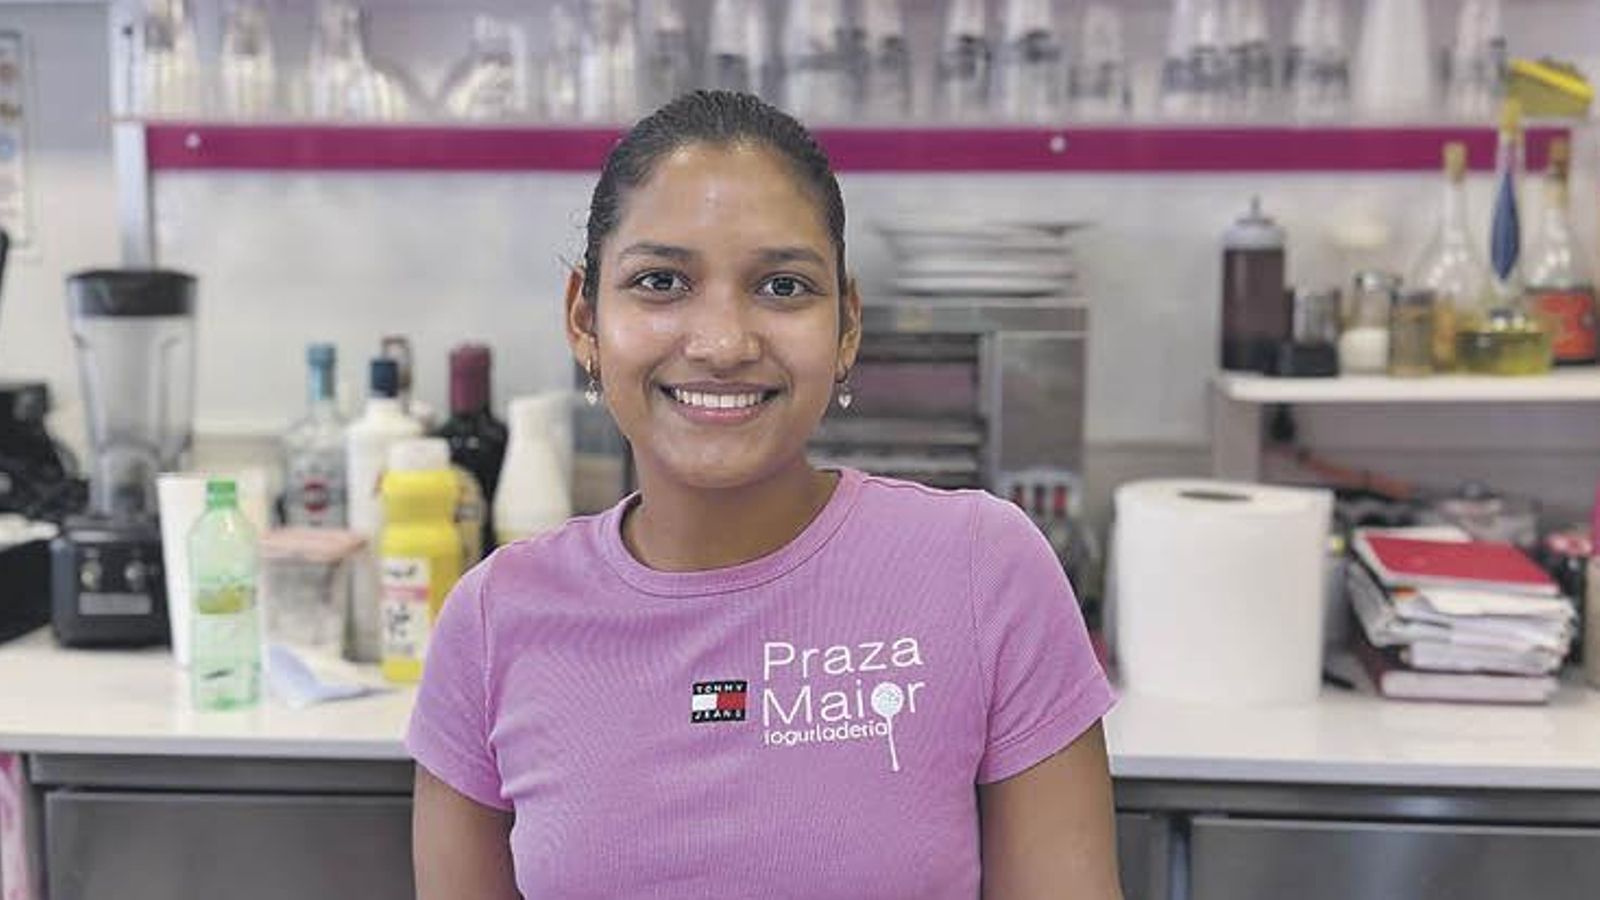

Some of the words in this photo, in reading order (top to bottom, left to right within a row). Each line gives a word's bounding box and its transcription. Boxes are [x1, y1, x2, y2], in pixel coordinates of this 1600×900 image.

[763, 637, 923, 681] Praza
[696, 684, 743, 693] TOMMY
[694, 710, 741, 720] JEANS
[763, 679, 925, 727] Maior
